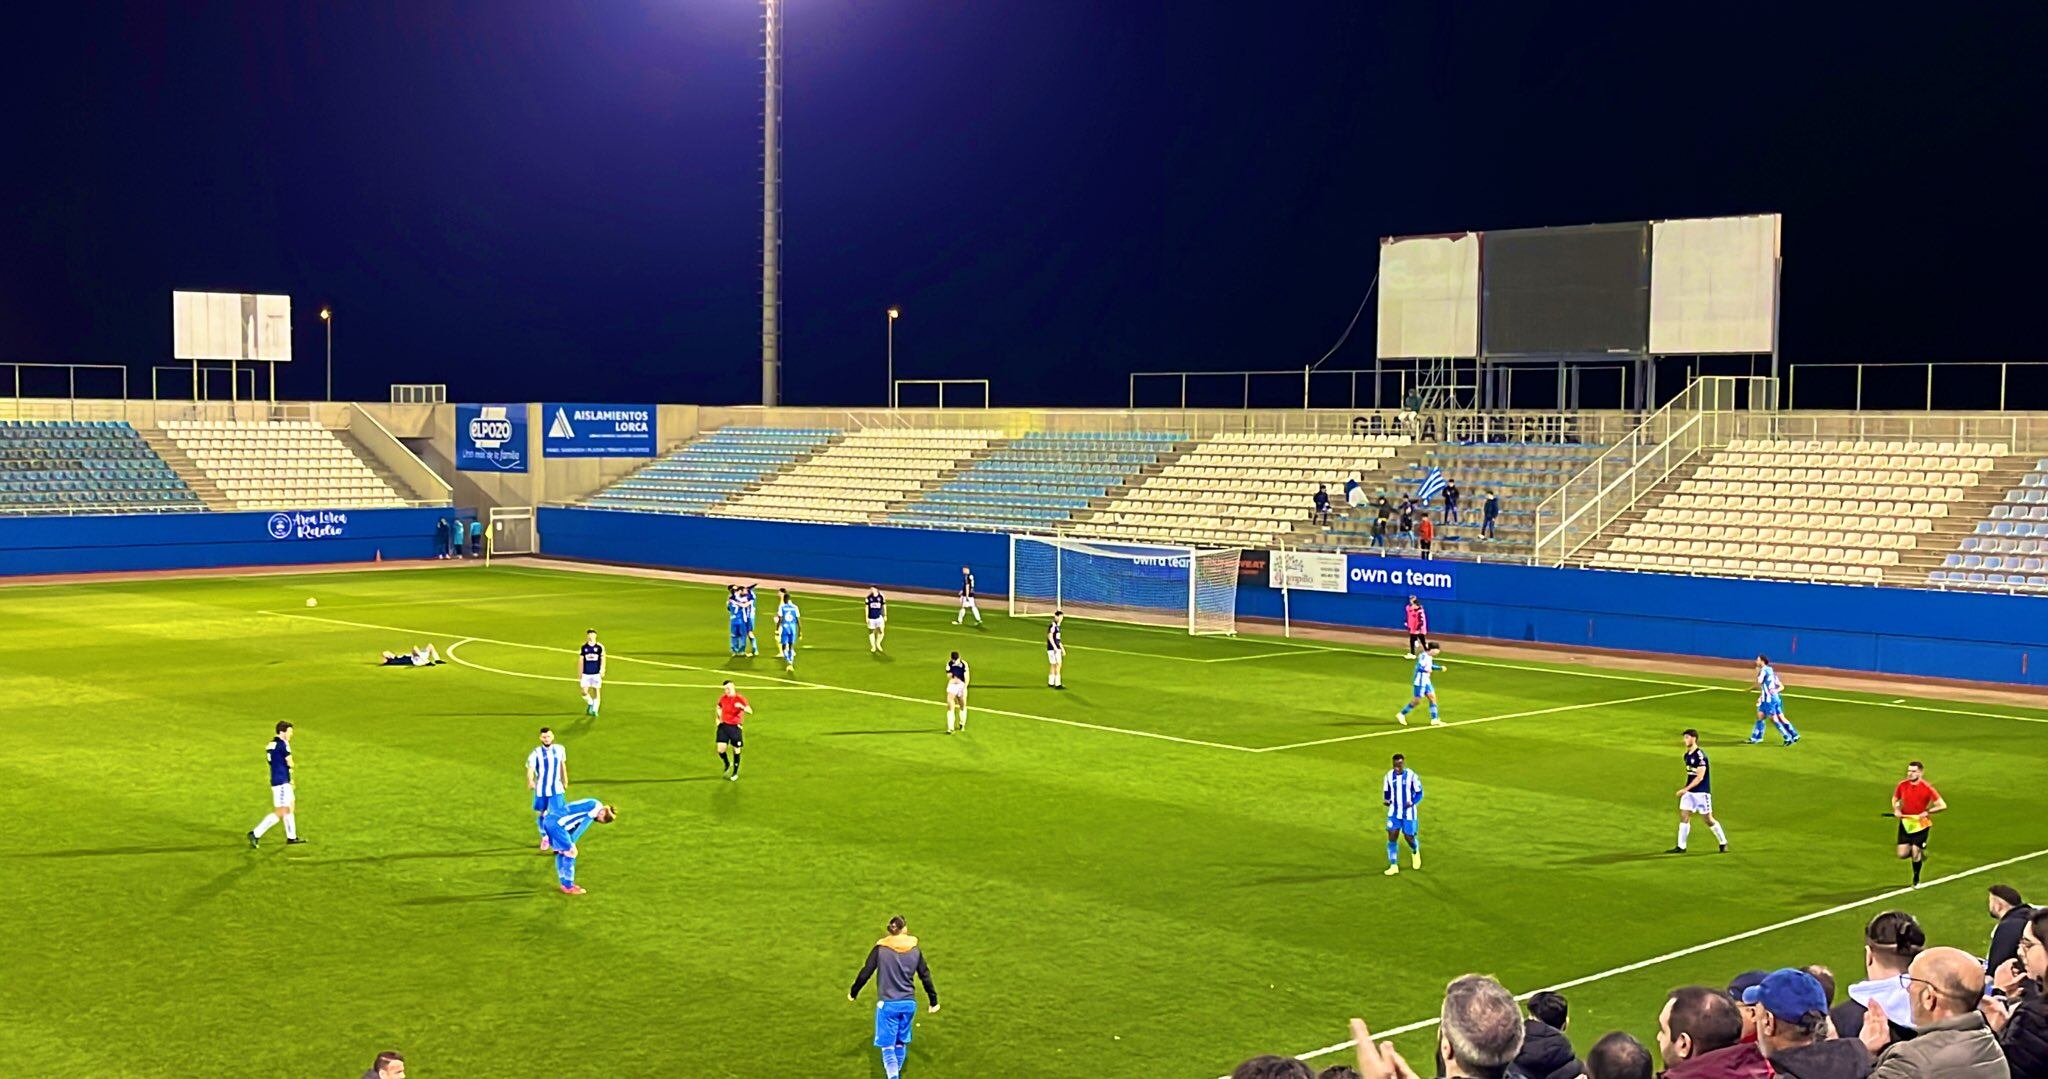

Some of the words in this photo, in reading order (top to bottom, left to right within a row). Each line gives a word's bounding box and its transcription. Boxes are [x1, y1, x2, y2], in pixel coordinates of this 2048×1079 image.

[574, 410, 648, 420] AISLAMIENTOS
[615, 422, 648, 431] LORCA
[1351, 568, 1387, 583] own
[1391, 570, 1402, 584] a
[1406, 569, 1452, 588] team
